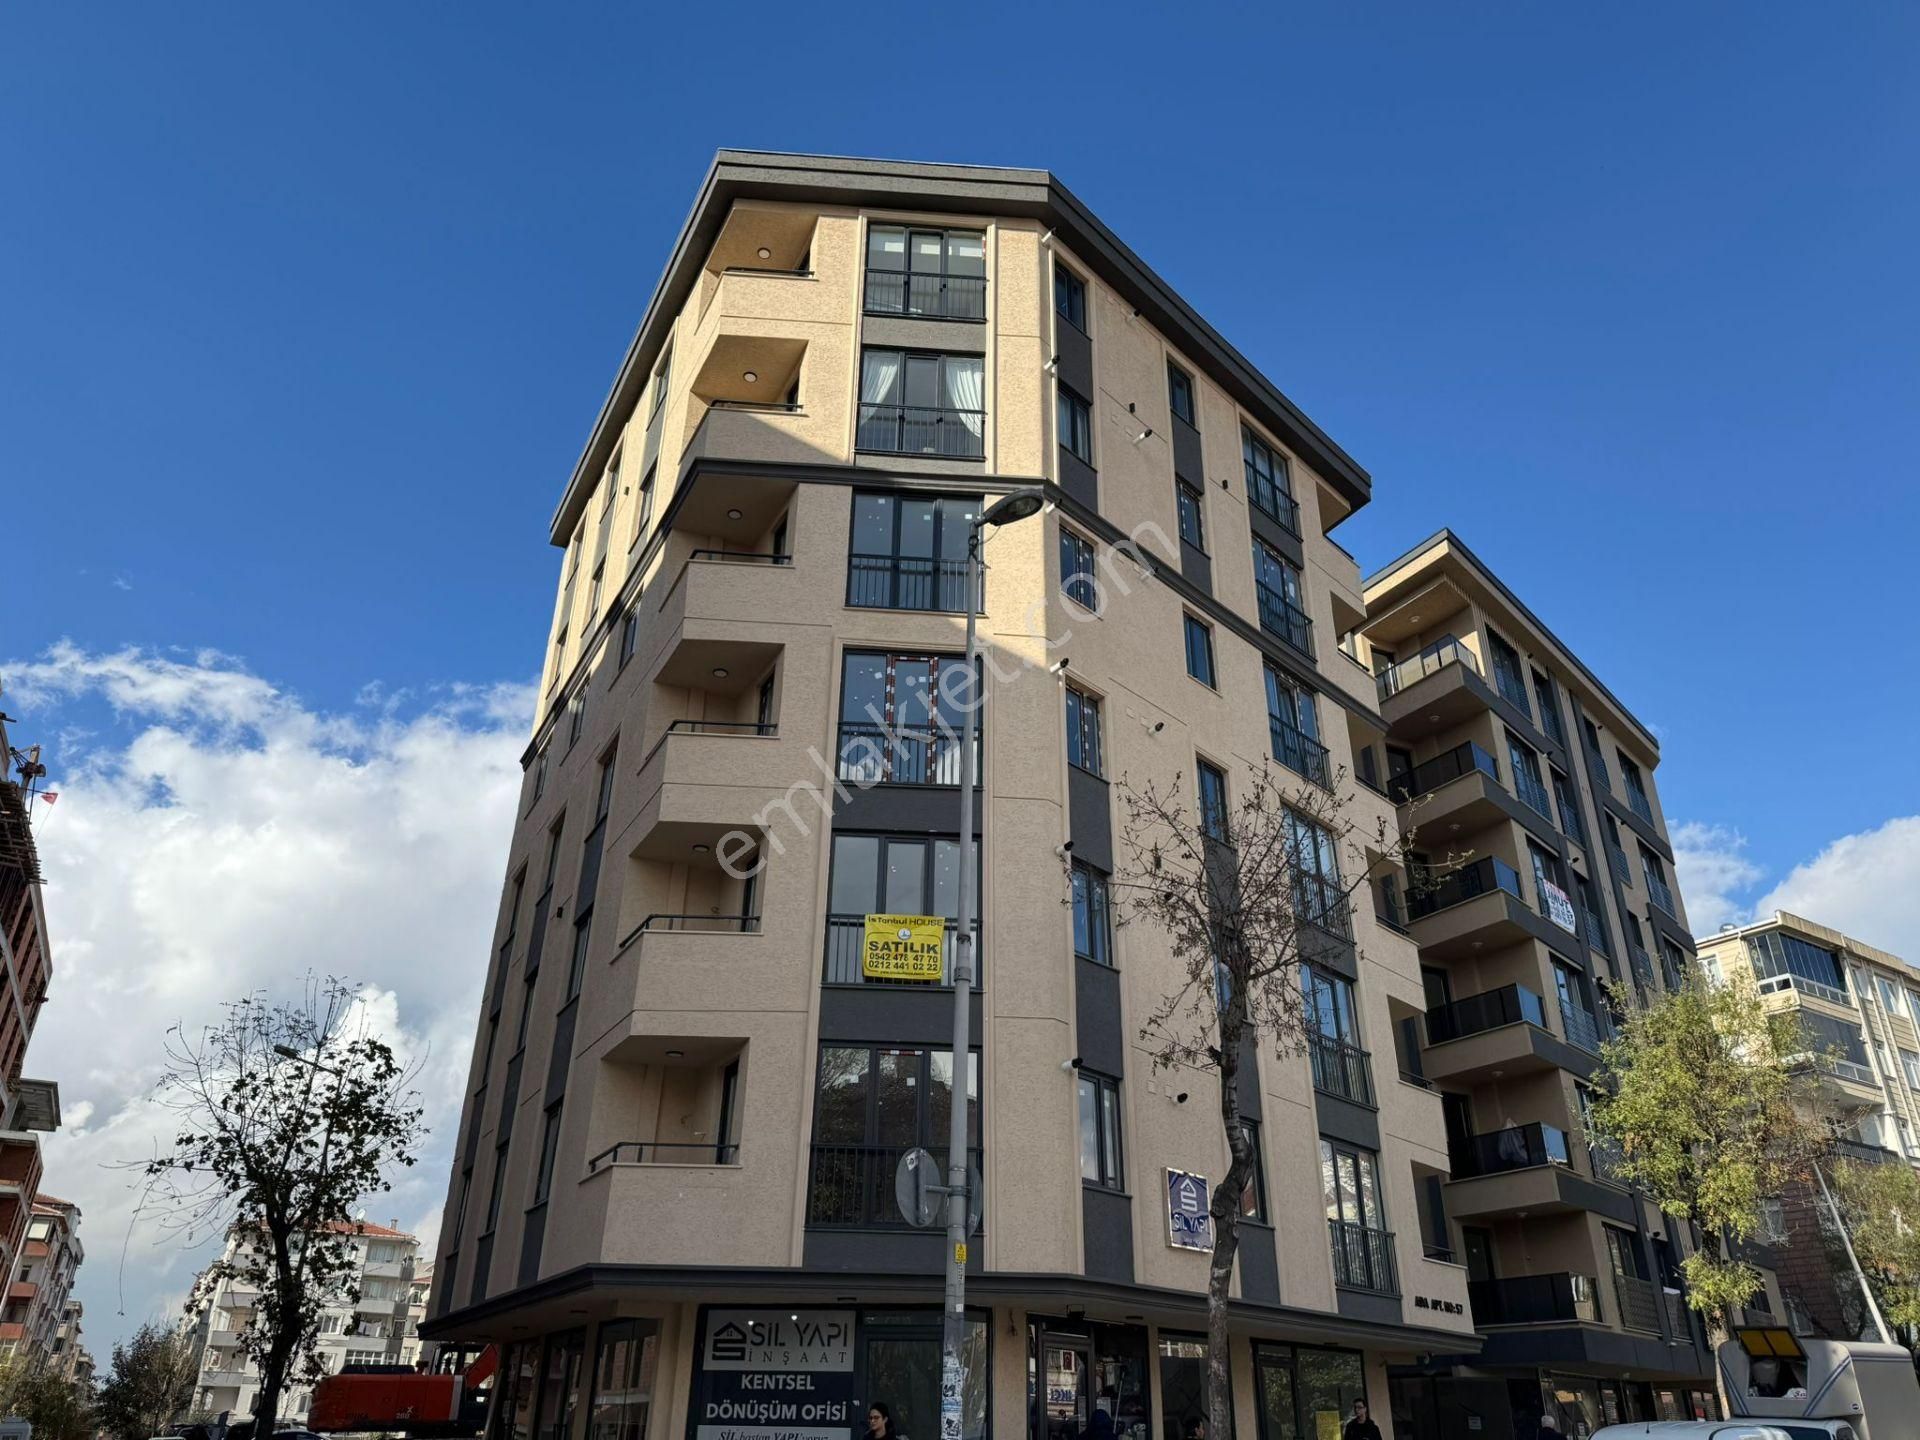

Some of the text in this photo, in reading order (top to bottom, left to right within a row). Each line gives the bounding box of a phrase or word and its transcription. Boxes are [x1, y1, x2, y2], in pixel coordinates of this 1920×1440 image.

[909, 918, 943, 927] HOUSE
[868, 940, 939, 954] SATILIK
[869, 952, 891, 961] 0542
[913, 954, 925, 963] 47
[926, 955, 938, 963] 70
[868, 960, 938, 972] 0212 441 02 22
[750, 1322, 848, 1347] SİL YAPI
[748, 1348, 847, 1365] İNŞAAT
[740, 1374, 815, 1390] KENTSEL
[706, 1399, 847, 1424] DÖNÜŞÜM OFİSİ
